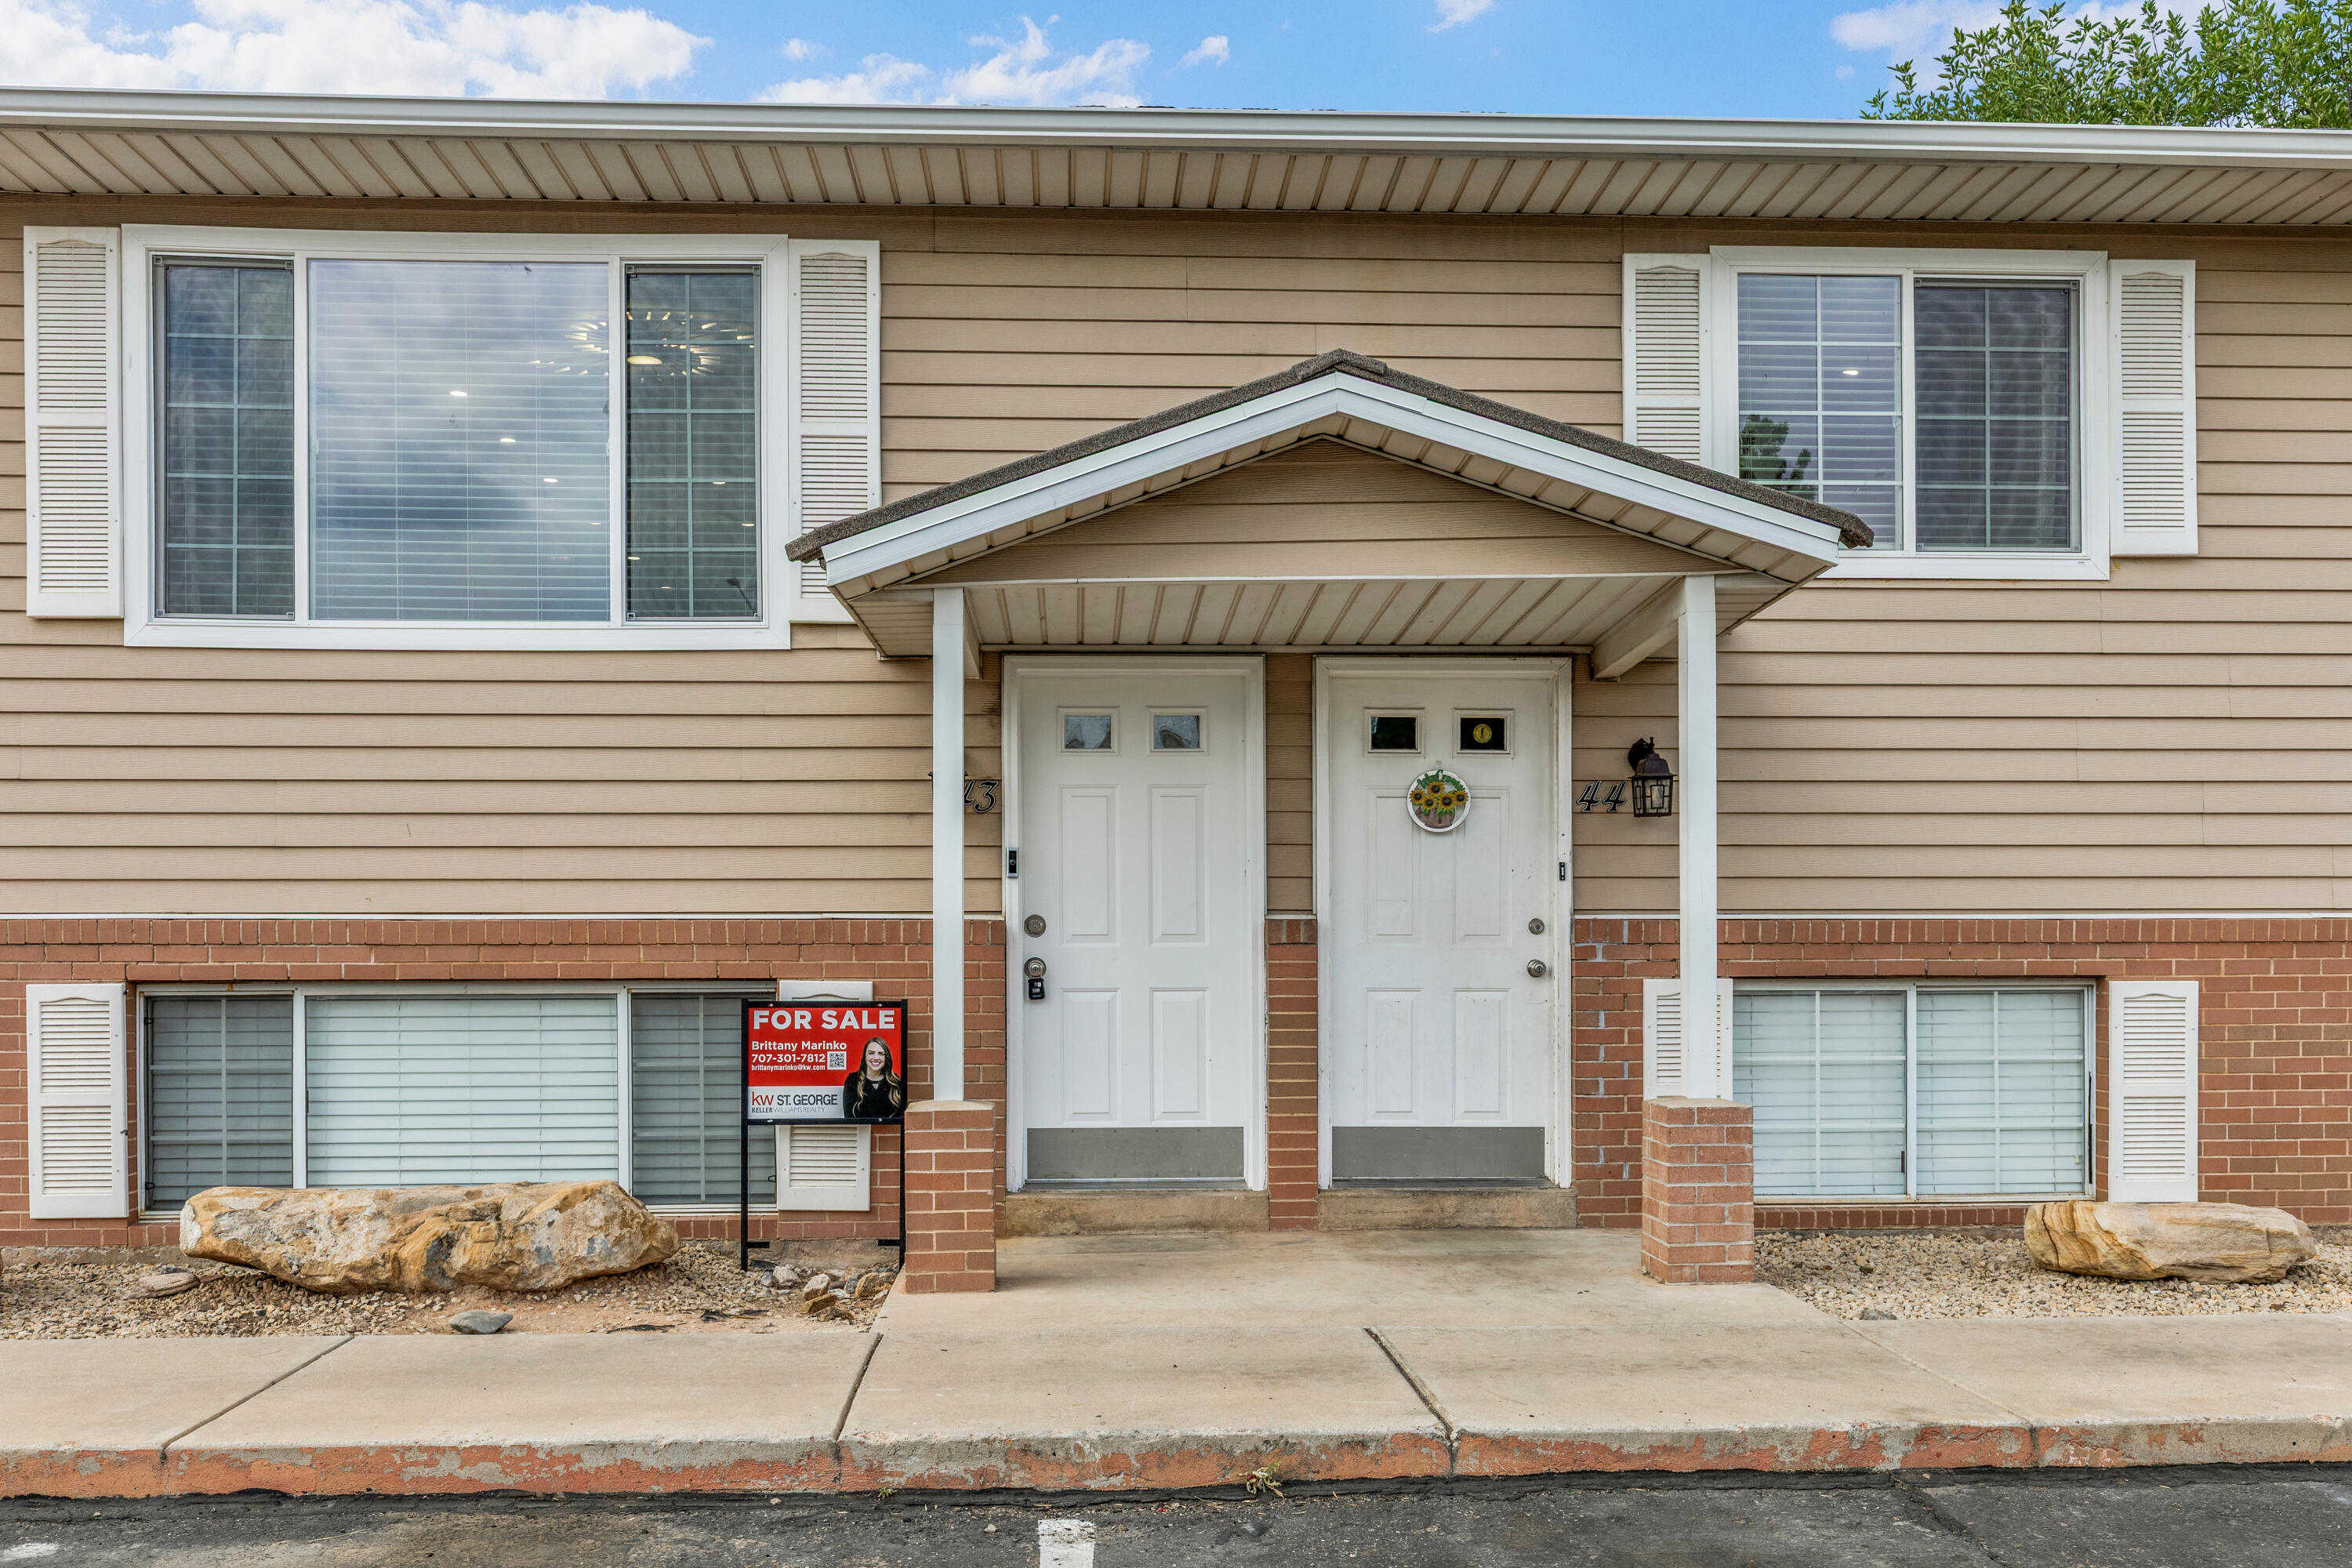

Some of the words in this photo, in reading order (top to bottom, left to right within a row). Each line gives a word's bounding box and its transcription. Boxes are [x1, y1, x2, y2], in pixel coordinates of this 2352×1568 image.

[1577, 780, 1627, 812] 44
[753, 1010, 812, 1029] FOR
[821, 1010, 895, 1029] SALE
[751, 1041, 798, 1051] Brittany
[801, 1040, 848, 1050] Marinko
[751, 1054, 826, 1063] 707-301-7812
[777, 1094, 791, 1106] ST.
[793, 1094, 838, 1106] GEORGE
